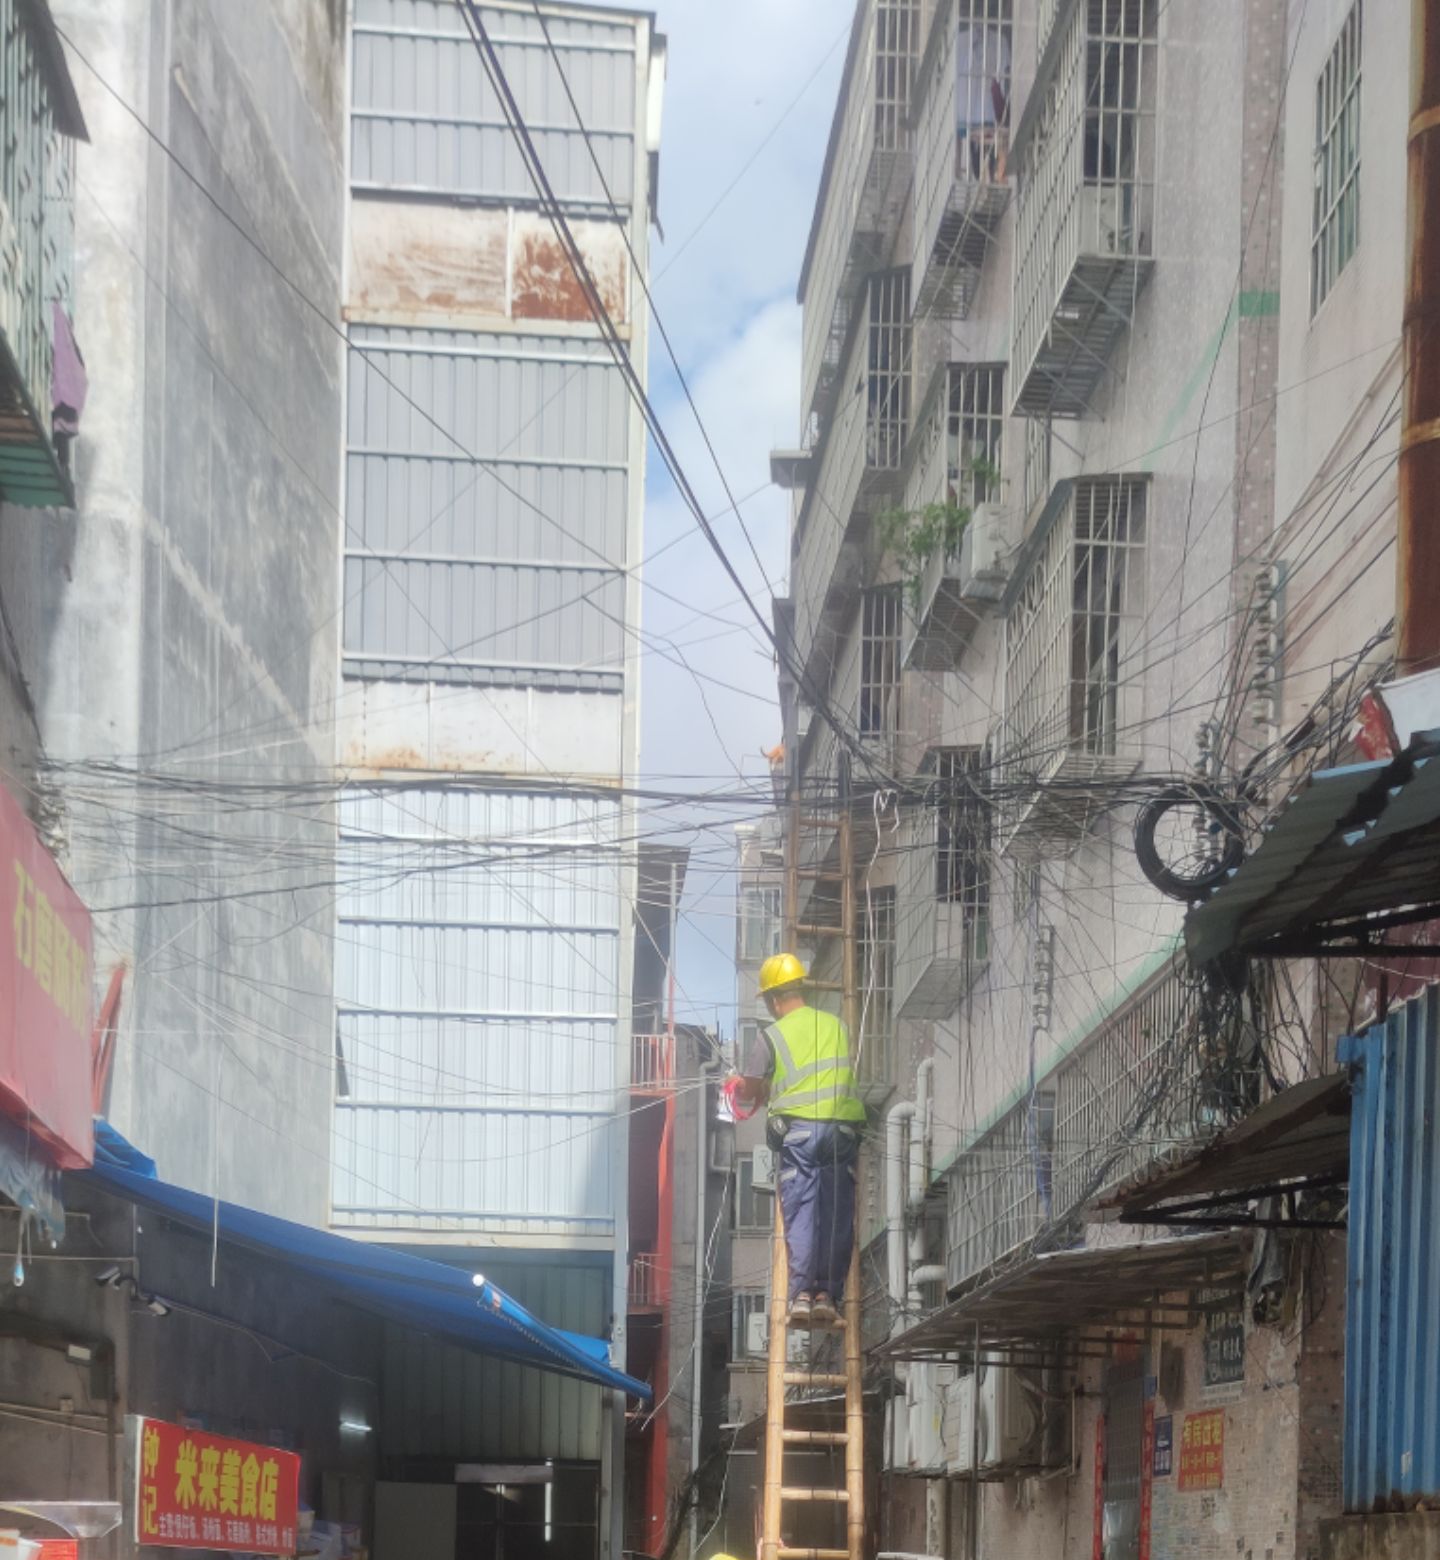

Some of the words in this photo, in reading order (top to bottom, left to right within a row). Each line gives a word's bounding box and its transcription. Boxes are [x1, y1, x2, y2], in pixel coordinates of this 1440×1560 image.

[143, 1425, 160, 1535] 钟记
[175, 1439, 279, 1521] 米来美食店
